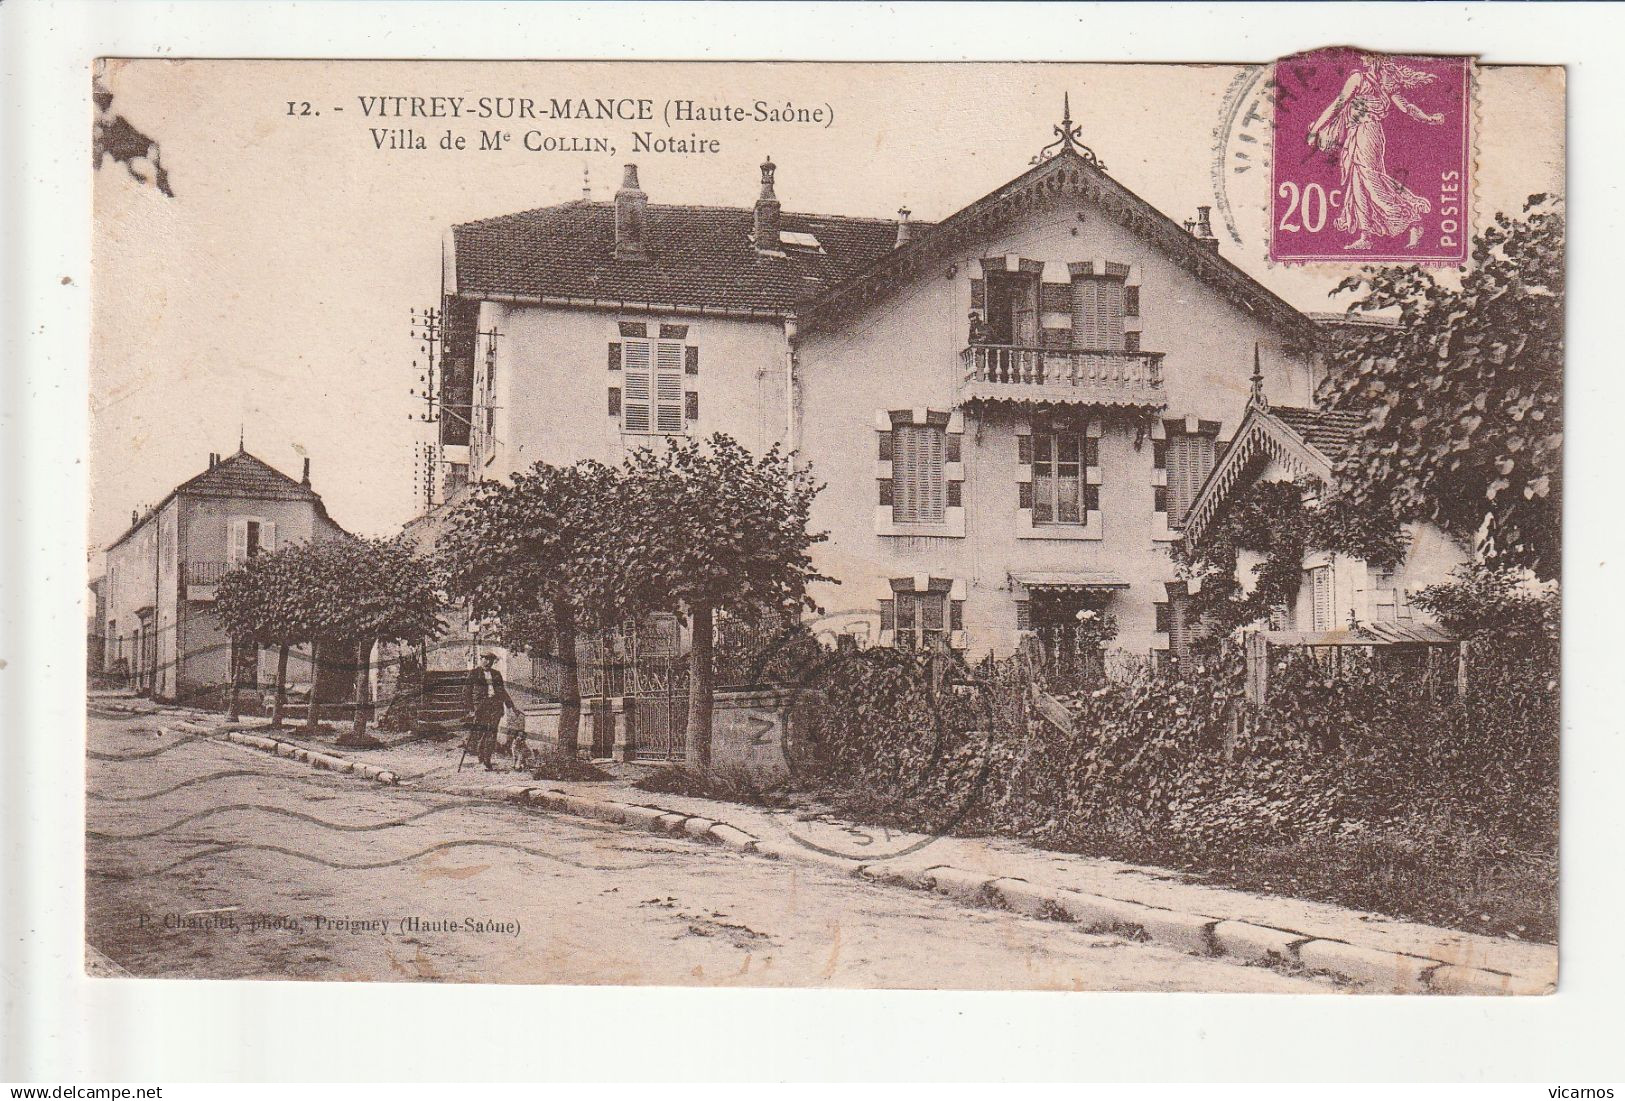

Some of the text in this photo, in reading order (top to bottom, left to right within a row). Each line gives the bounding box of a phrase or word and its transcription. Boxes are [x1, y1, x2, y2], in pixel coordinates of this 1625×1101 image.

[286, 101, 321, 117] 12.
[357, 95, 654, 120] VITREY-SUR-MANCE
[663, 99, 834, 129] (Haute-Saône)
[368, 127, 428, 151] Villa
[439, 129, 466, 151] de
[631, 131, 721, 154] Notaire
[1440, 170, 1459, 247] POSTES
[315, 914, 390, 936] Preigney
[400, 916, 521, 937] (Haute-Saône)
